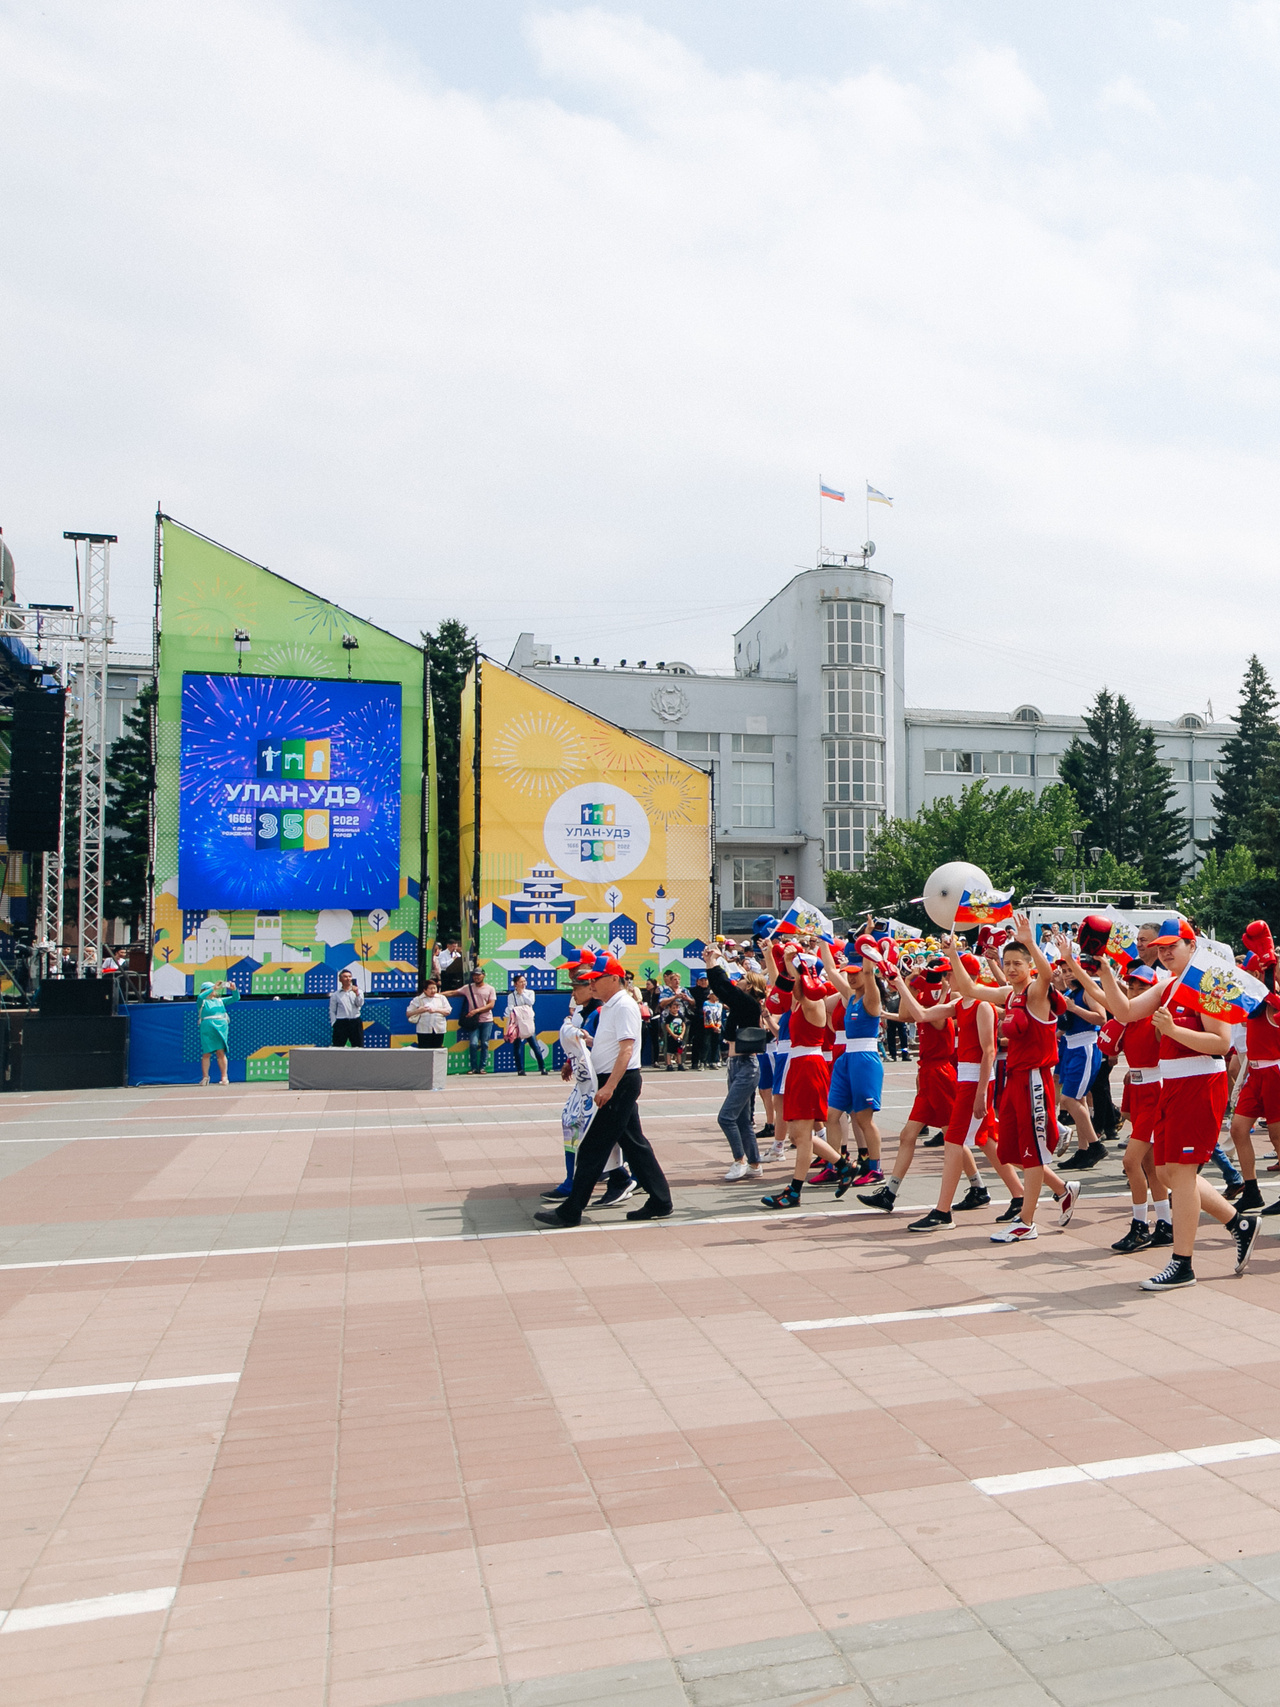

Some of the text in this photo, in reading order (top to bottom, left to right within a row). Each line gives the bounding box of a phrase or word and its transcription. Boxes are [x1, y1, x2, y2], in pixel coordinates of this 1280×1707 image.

[225, 783, 361, 807] УЛАН-УДЭ
[228, 813, 252, 824] 1666
[332, 815, 360, 826] 2022
[565, 827, 631, 839] УЛАН-УДЭ
[1033, 1083, 1046, 1141] JORDAN
